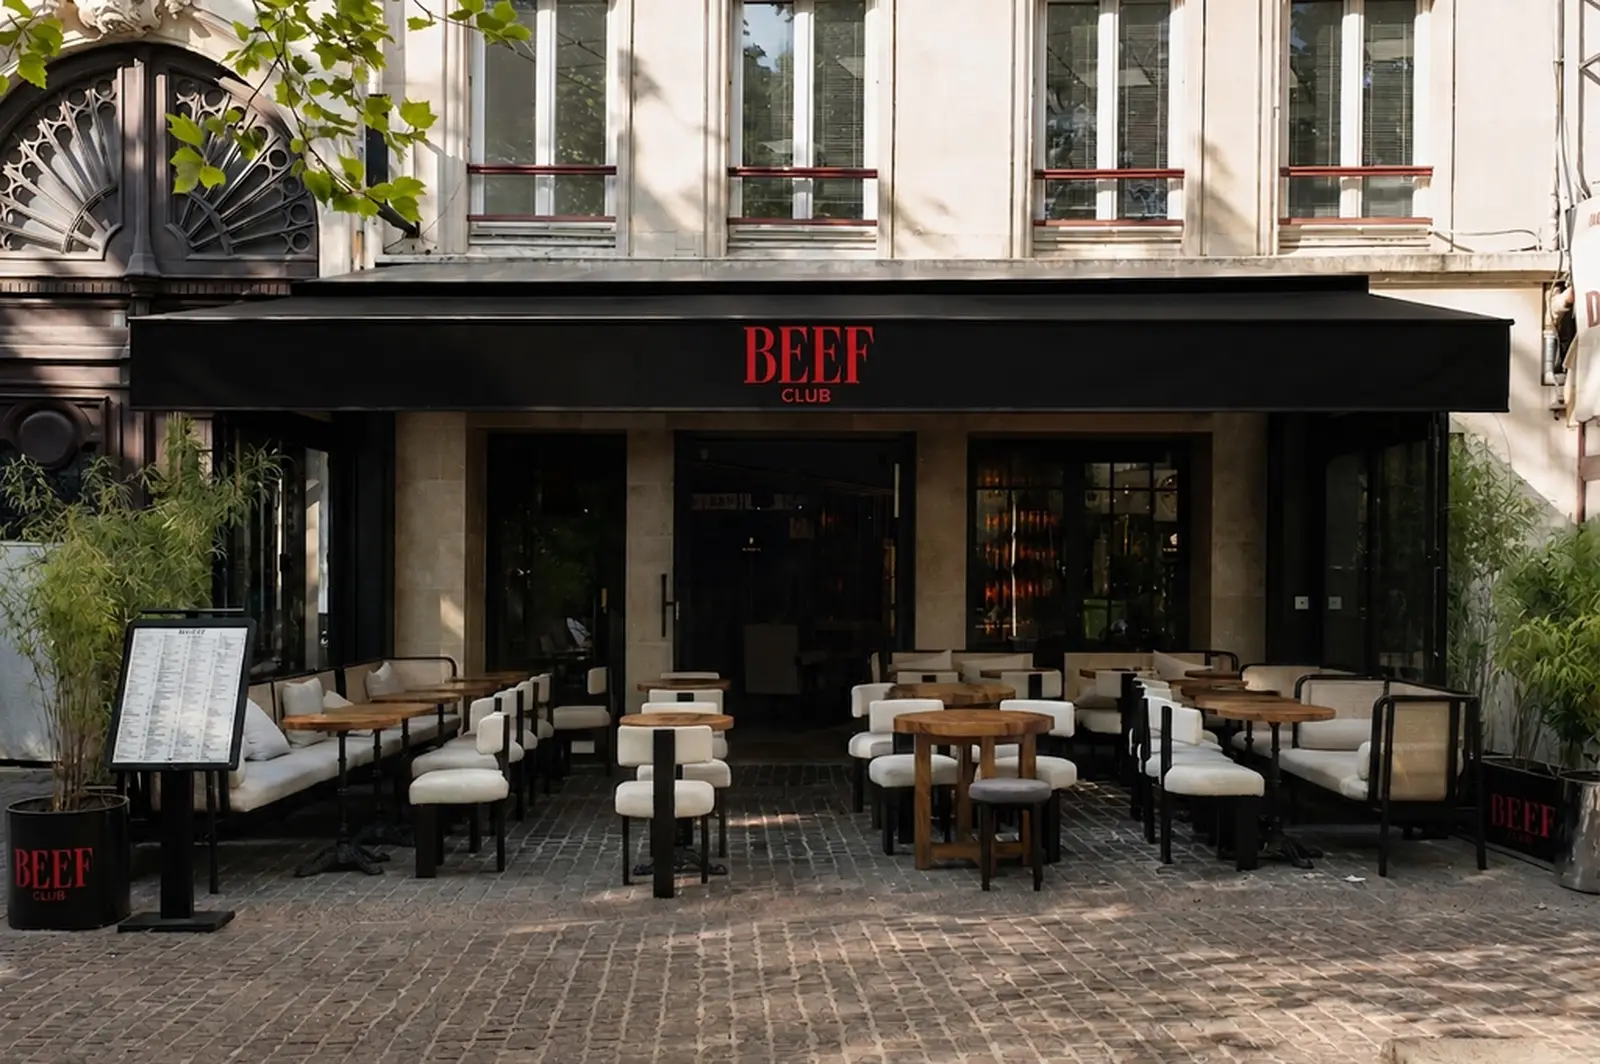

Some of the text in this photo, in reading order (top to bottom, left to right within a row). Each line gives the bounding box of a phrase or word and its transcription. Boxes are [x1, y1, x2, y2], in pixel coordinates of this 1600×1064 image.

[744, 326, 875, 384] BEEF
[781, 388, 831, 403] CLUB
[1491, 792, 1556, 838] BEEF
[14, 847, 94, 890] BEEF
[33, 890, 66, 901] CLUB
